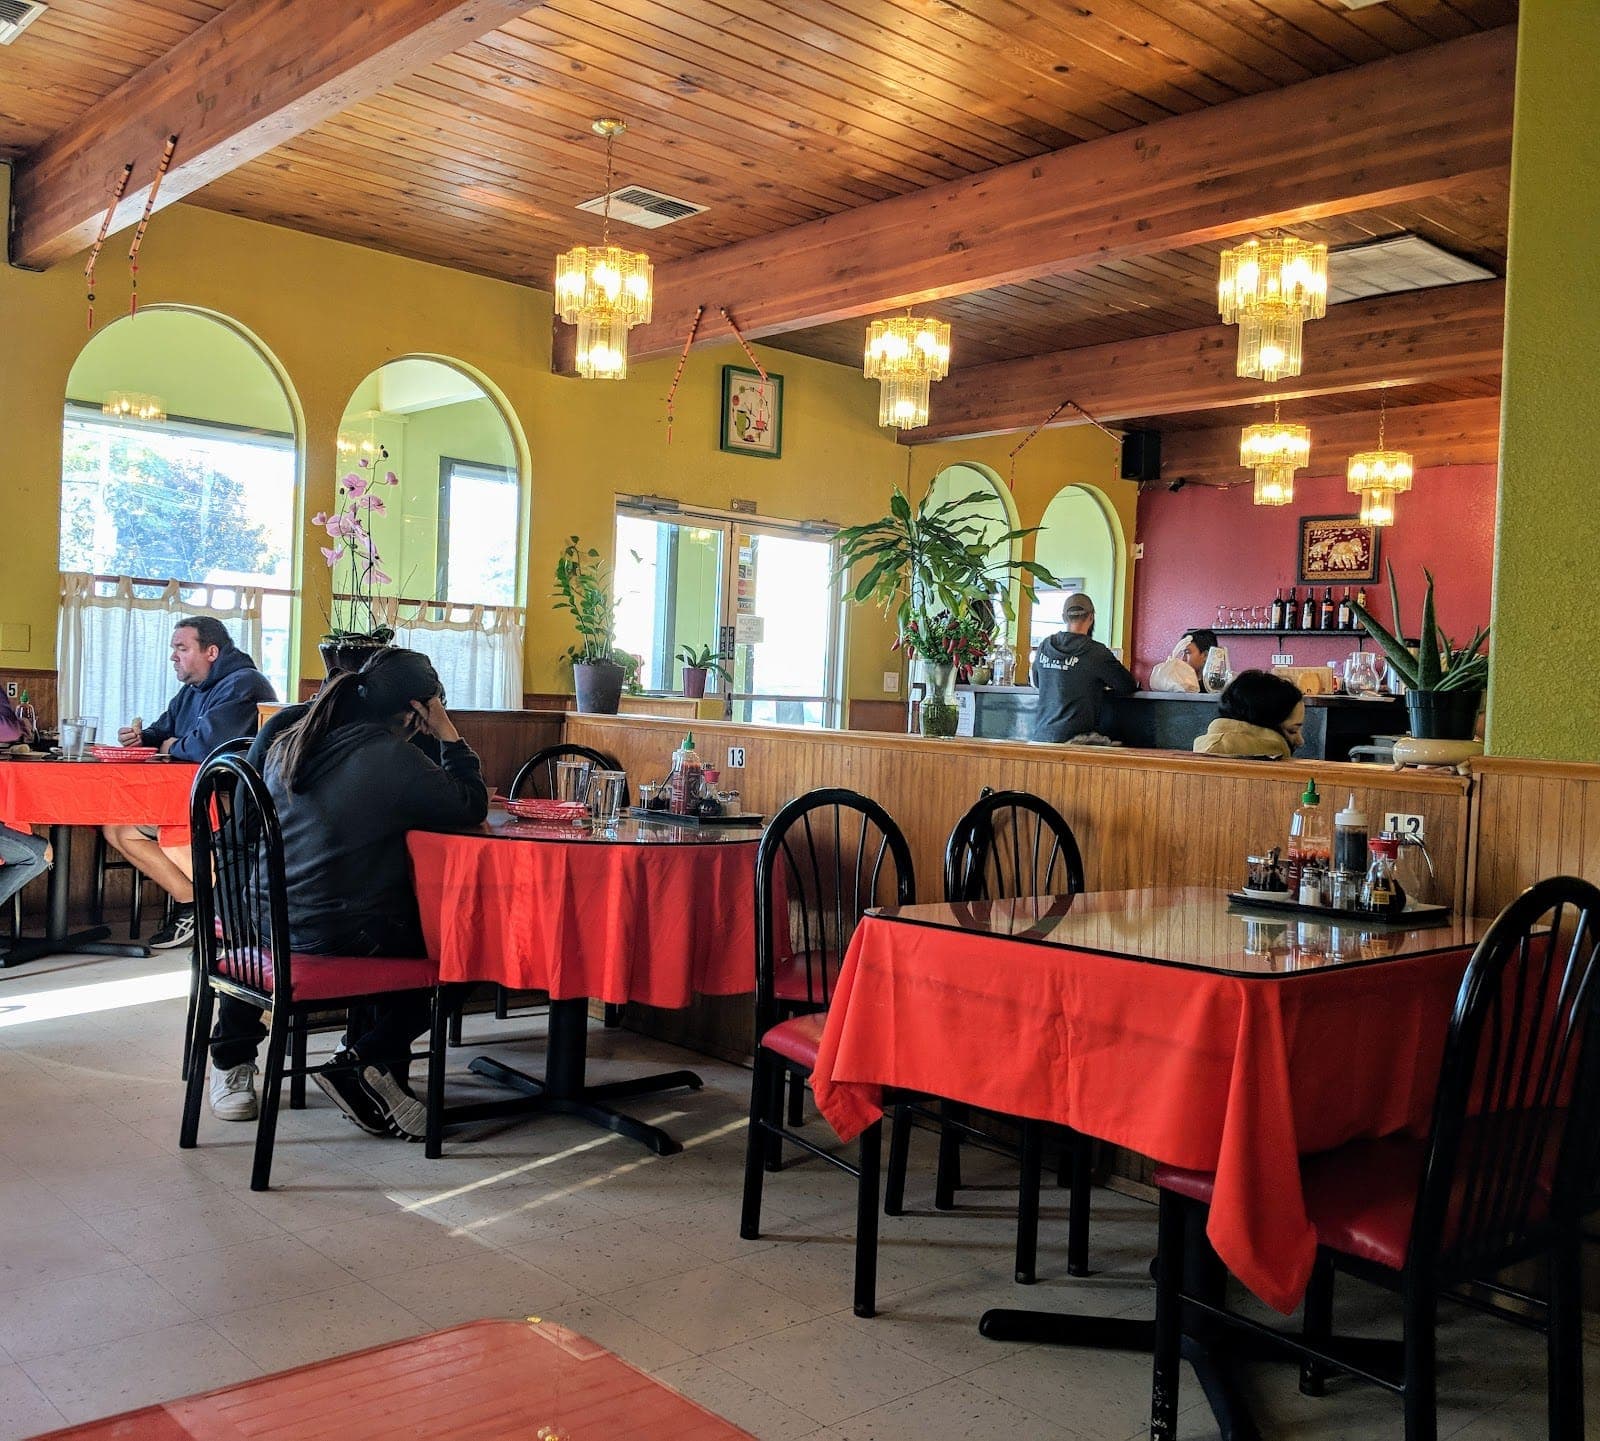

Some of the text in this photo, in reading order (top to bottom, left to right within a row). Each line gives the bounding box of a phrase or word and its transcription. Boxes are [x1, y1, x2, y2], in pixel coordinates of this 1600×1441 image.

[1064, 655, 1079, 667] UP
[8, 683, 16, 697] 5
[731, 749, 744, 767] 13
[1390, 816, 1420, 833] 12
